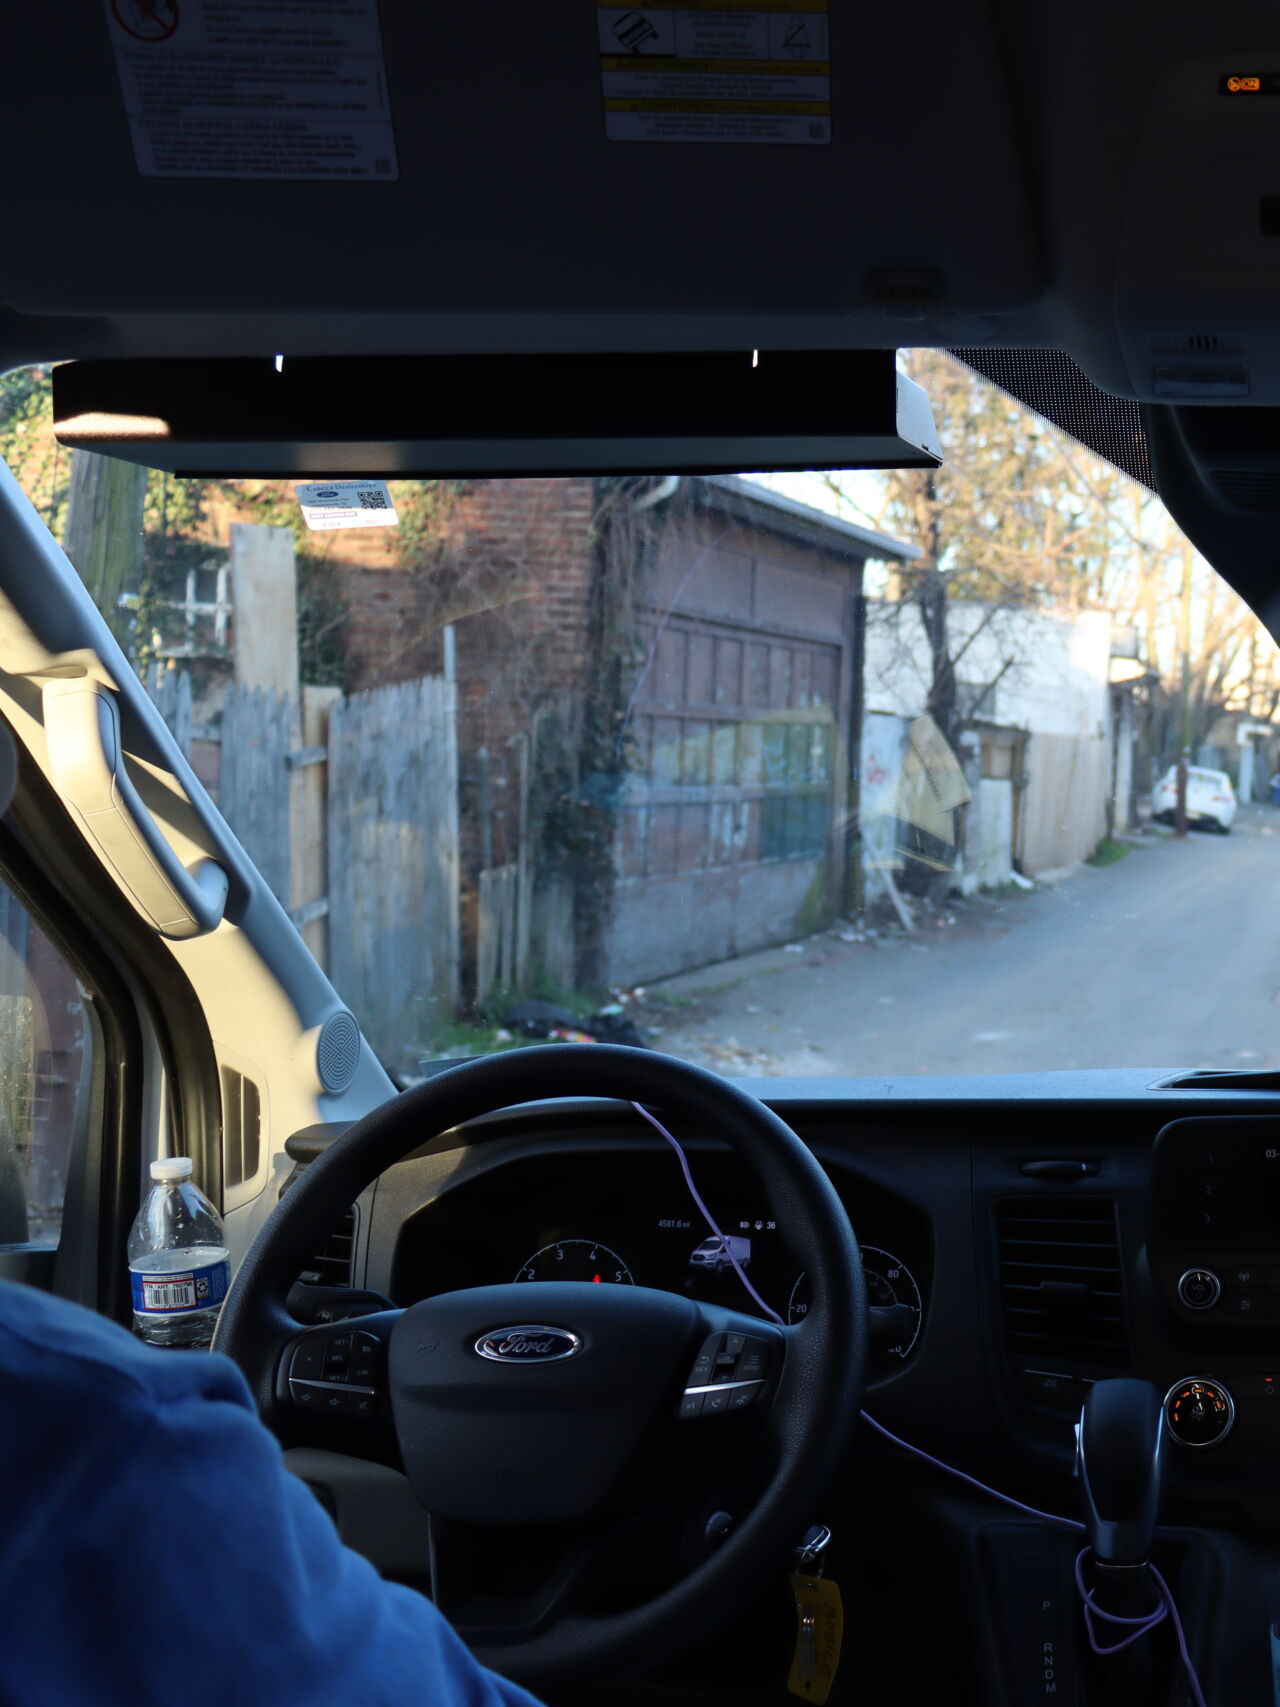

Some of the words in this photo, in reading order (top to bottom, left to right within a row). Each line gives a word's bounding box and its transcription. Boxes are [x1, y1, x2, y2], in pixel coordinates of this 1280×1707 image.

[1204, 1184, 1213, 1195] 2
[658, 1219, 682, 1229] 4581.6
[1203, 1214, 1212, 1224] 3
[556, 1250, 564, 1261] 3
[589, 1250, 597, 1261] 4
[528, 1269, 536, 1281] 2
[614, 1270, 623, 1282] 5
[888, 1269, 900, 1279] 80
[795, 1304, 808, 1314] 20
[496, 1331, 554, 1356] Ford
[1042, 1600, 1052, 1611] P
[1043, 1642, 1054, 1653] R
[1044, 1655, 1053, 1666] N
[1045, 1669, 1054, 1680] D
[1045, 1682, 1057, 1694] M
